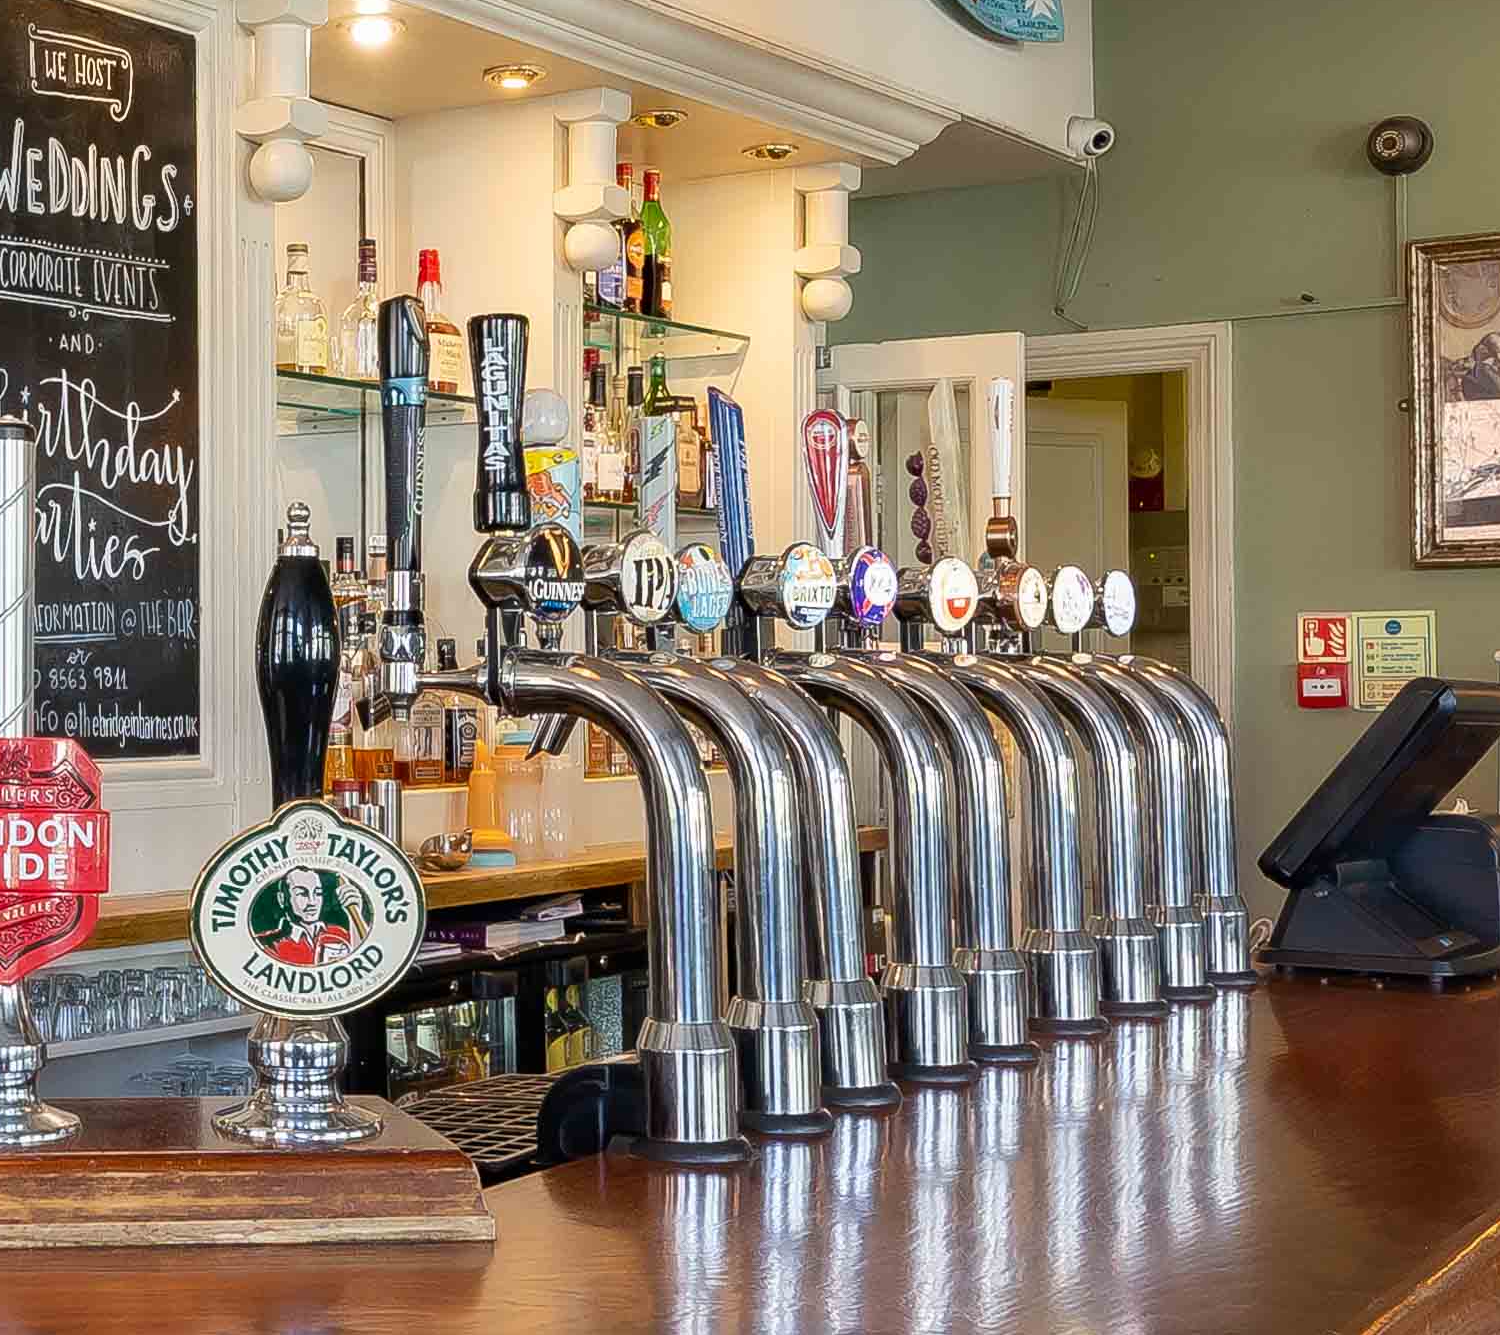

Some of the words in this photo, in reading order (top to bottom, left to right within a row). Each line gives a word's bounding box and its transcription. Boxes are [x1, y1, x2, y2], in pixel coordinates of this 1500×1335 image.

[44, 50, 67, 83] WE
[74, 53, 117, 91] HOST
[0, 247, 83, 298] CORPORATE
[93, 258, 159, 311] EVENTS
[59, 334, 95, 355] AND
[480, 337, 511, 471] LAGUNITAS
[414, 426, 426, 515] GUINNESS
[534, 578, 586, 601] GUINNESS
[631, 557, 678, 610] IPA
[139, 600, 165, 638] THE
[168, 598, 195, 639] BAR
[48, 666, 88, 690] 8563
[94, 665, 129, 690] 9811
[66, 649, 93, 665] or
[212, 835, 289, 933] TIMOTHY
[327, 833, 408, 925] TAYLOR'S
[29, 900, 52, 914] ALE
[242, 944, 384, 994] LANDLORD
[261, 987, 299, 1003] CLASSIC
